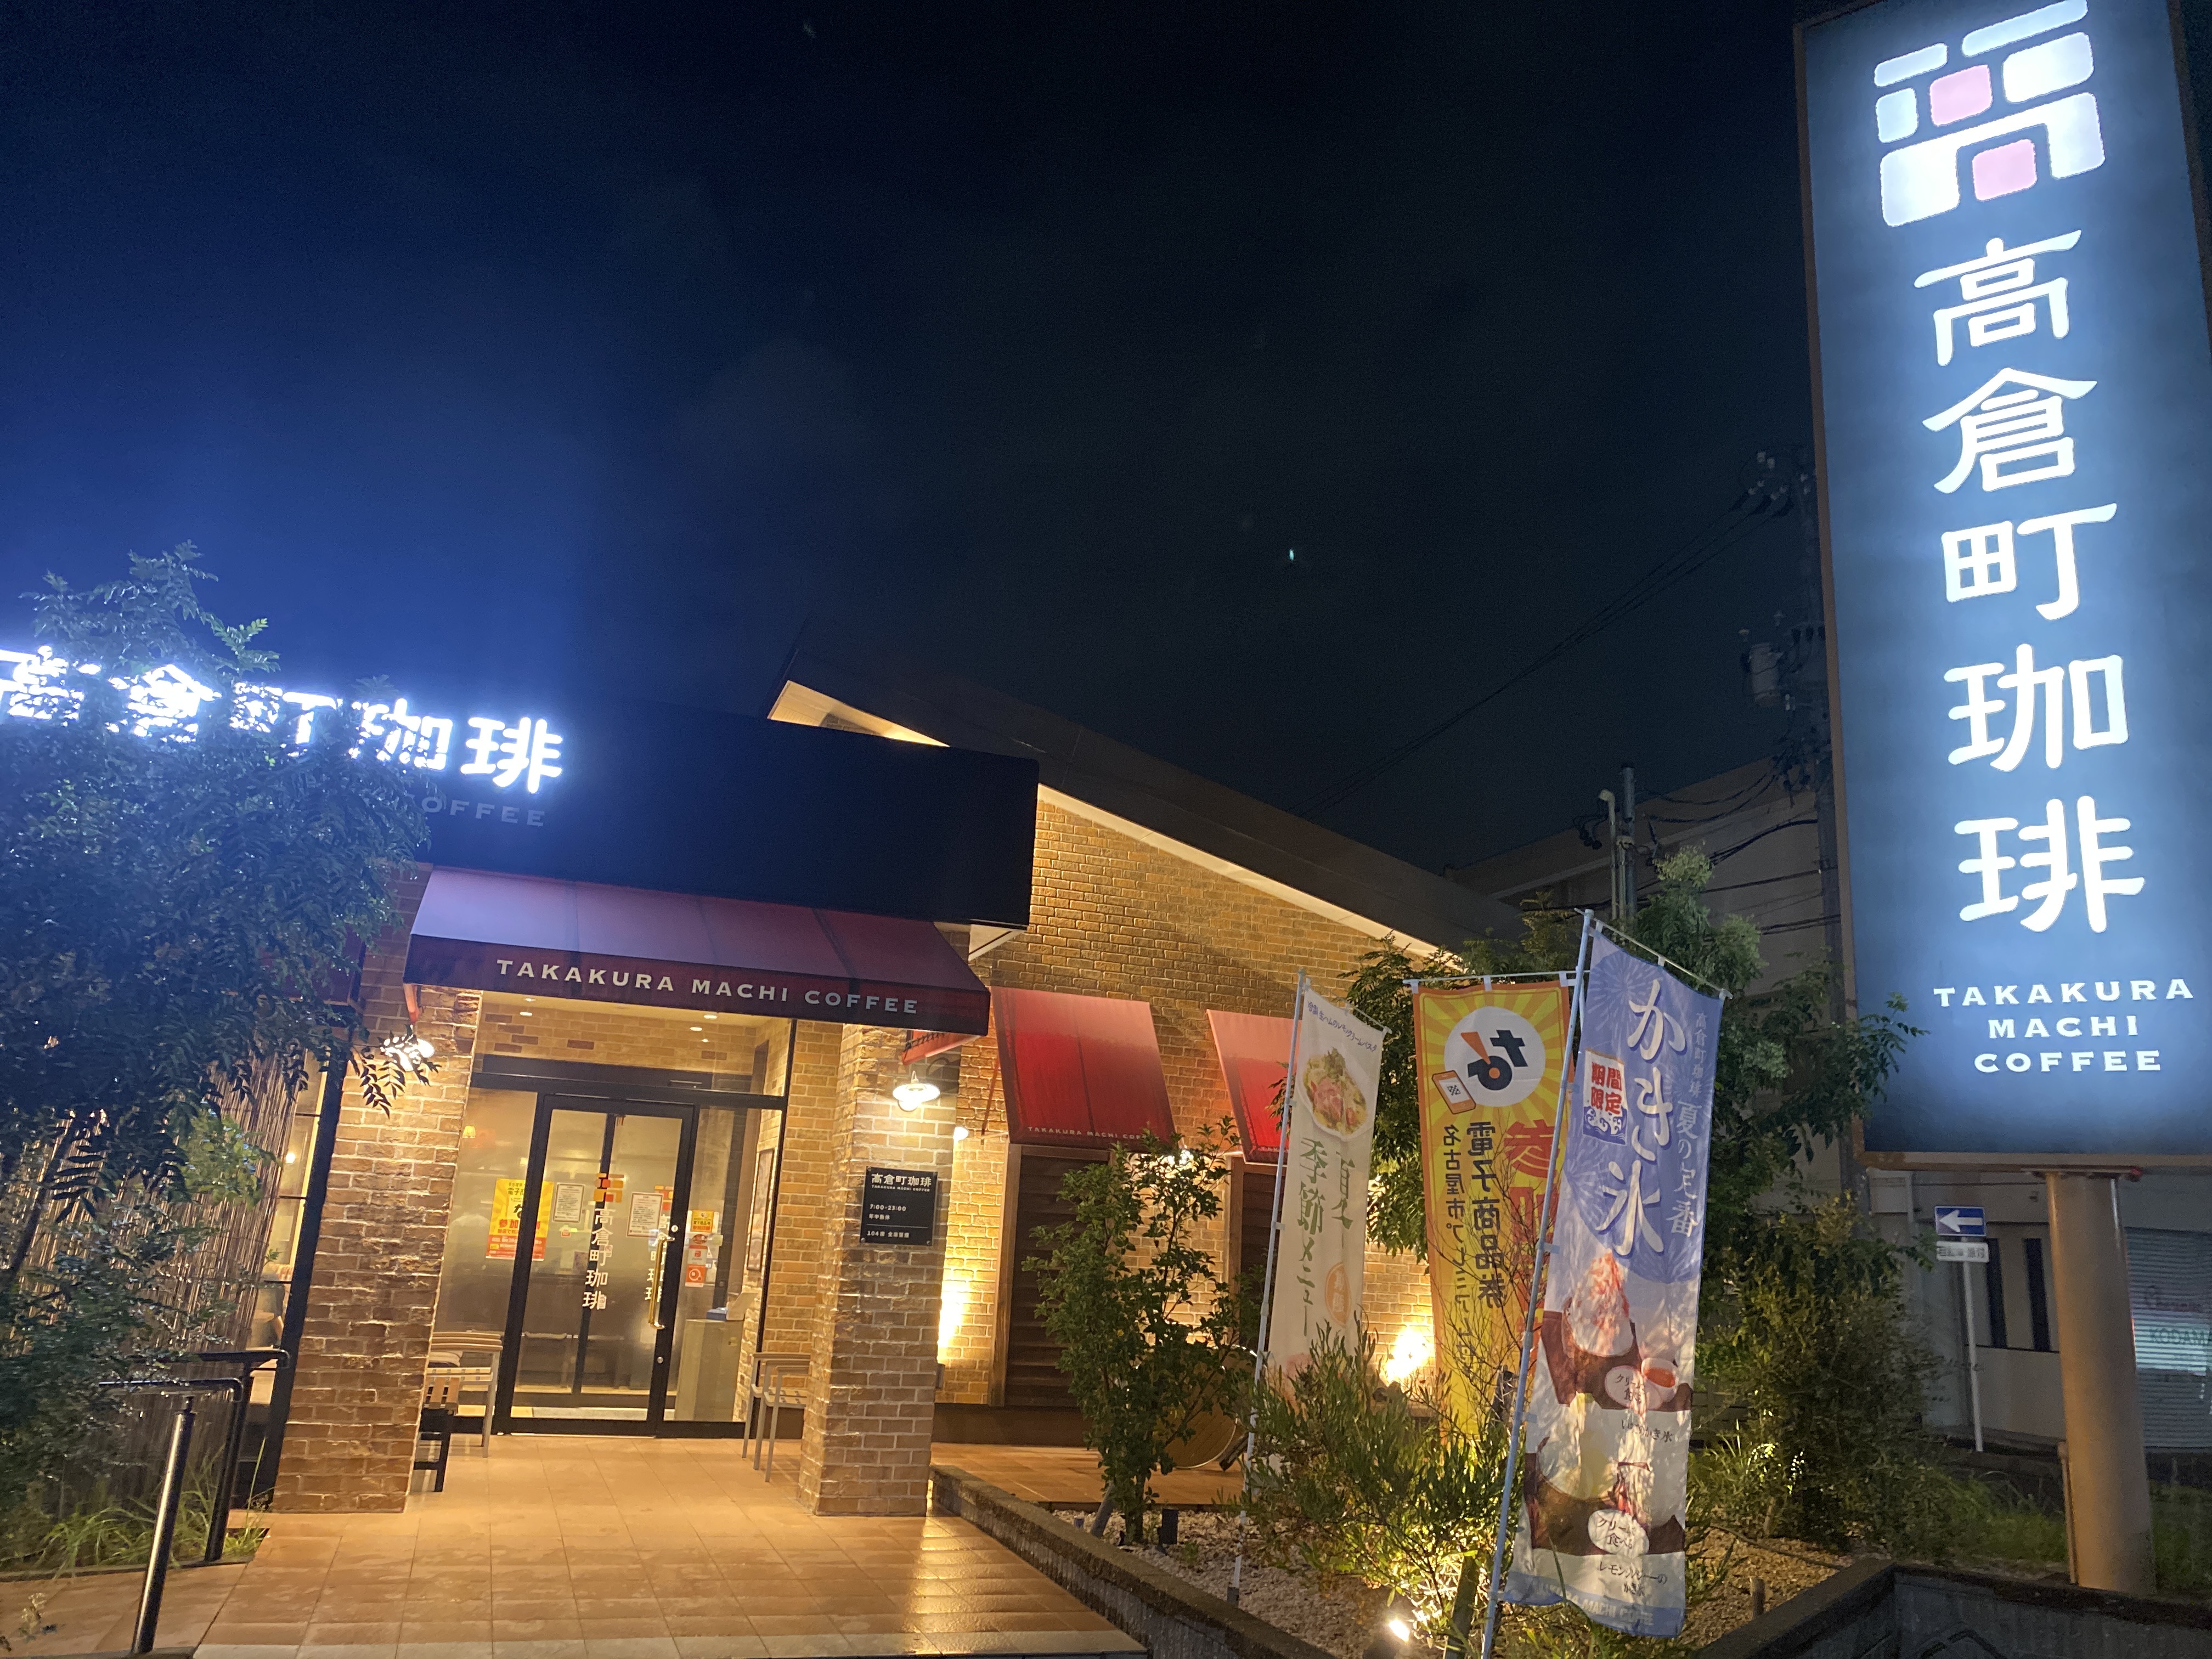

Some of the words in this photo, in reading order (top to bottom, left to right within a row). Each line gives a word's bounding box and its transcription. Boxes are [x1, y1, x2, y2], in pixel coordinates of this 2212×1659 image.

[1914, 229, 2146, 934] 高倉町珈琲
[421, 797, 545, 827] OFFEE
[496, 959, 674, 992] TAKAKURA
[691, 979, 789, 1002] MACHI
[805, 990, 919, 1015] COFFEE
[1933, 978, 2193, 1007] TAKAKURA
[1988, 1014, 2139, 1039] MACHI
[1973, 1049, 2161, 1073] COFFEE
[1028, 1126, 1082, 1136] TAKAKURA
[1595, 979, 1687, 1256] かき氷
[871, 1173, 932, 1187] 高倉町珈琲
[582, 1204, 617, 1310] 高倉町珈琲
